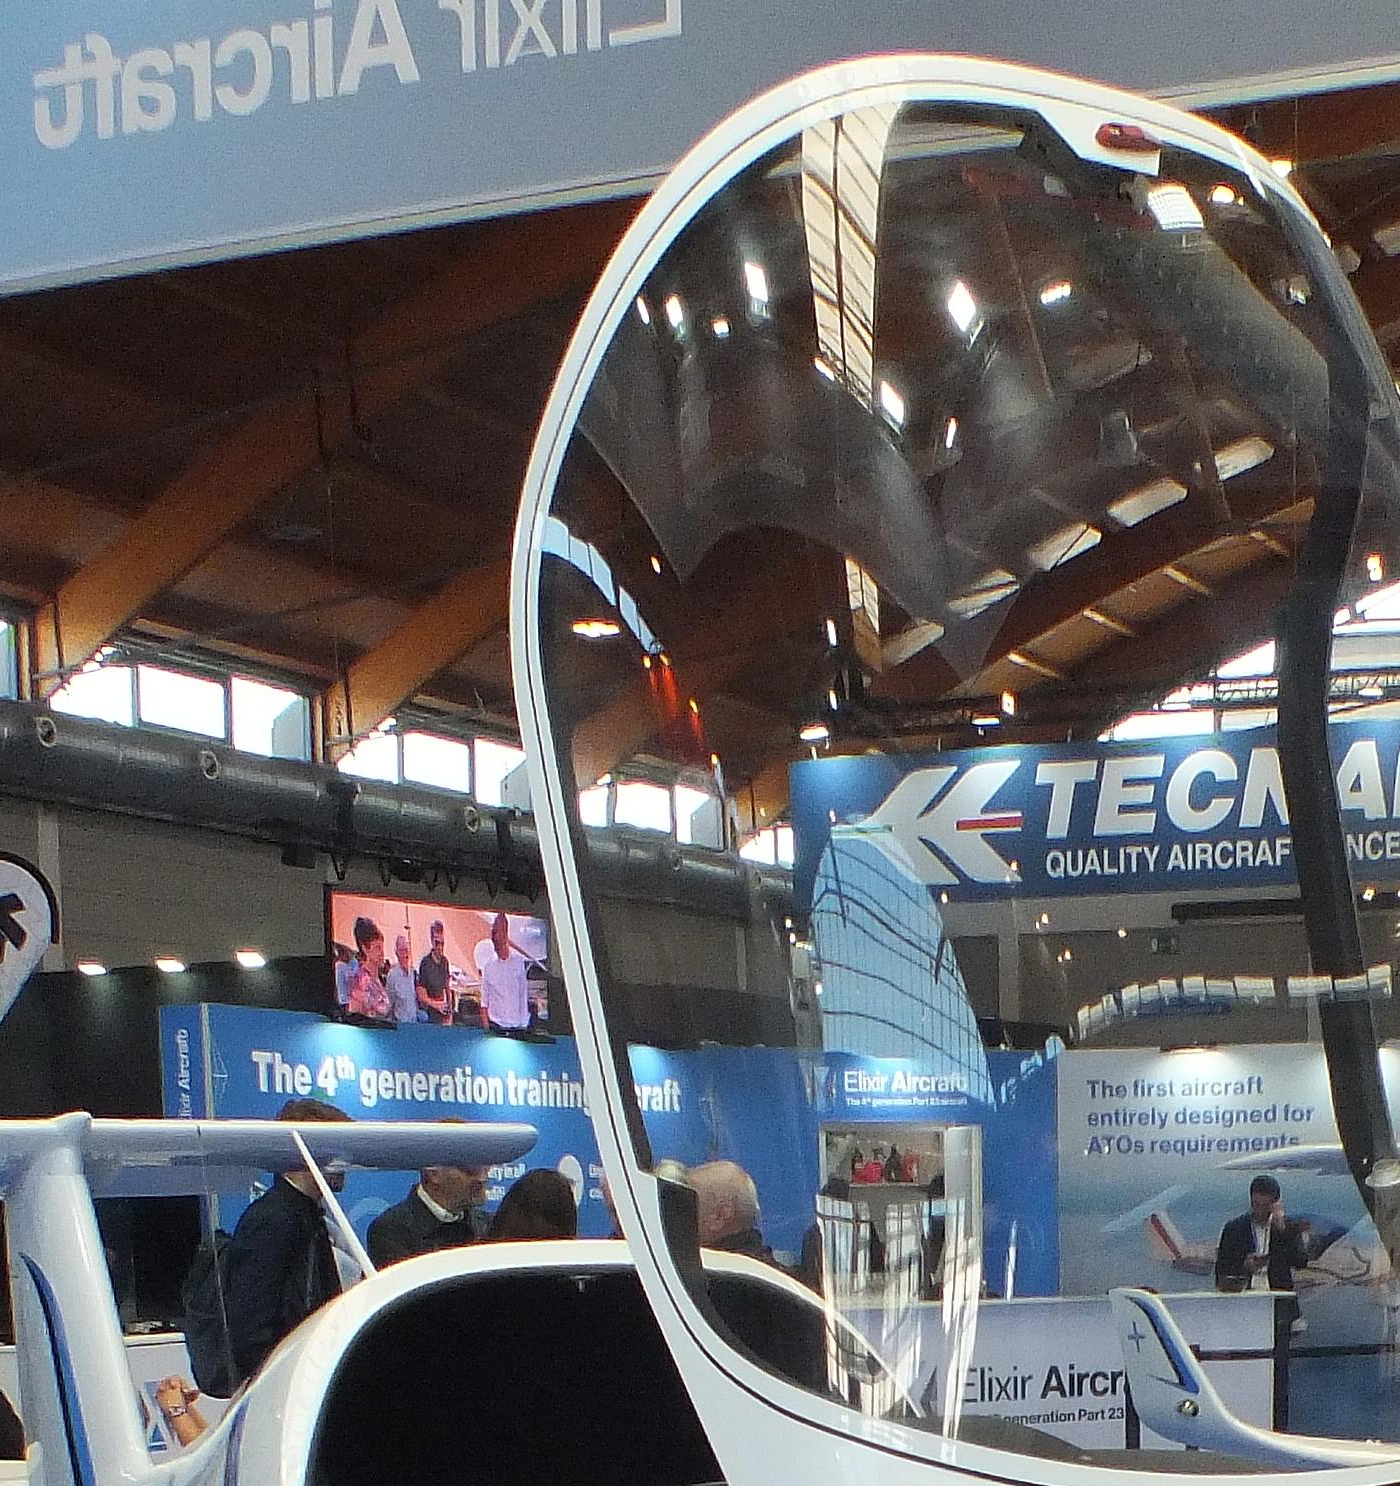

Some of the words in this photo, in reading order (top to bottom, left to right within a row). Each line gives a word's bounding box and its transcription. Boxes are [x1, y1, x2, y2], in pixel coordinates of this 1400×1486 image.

[1046, 844, 1160, 878] QUALITY
[1166, 838, 1291, 872] AIRCRAF
[1345, 831, 1400, 861] NCE
[251, 1051, 313, 1095] The
[317, 1055, 355, 1097] 4th
[359, 1066, 504, 1108] generation
[634, 1079, 682, 1112] raft
[844, 1069, 888, 1093] Elixir
[891, 1070, 966, 1093] Aircraft
[1086, 1080, 1127, 1098] The
[1133, 1079, 1175, 1098] first
[1182, 1076, 1264, 1097] aircraft
[1087, 1108, 1168, 1129] entirely
[1174, 1104, 1277, 1127] designed
[1283, 1104, 1315, 1123] for
[1086, 1134, 1144, 1155] ATOs
[1151, 1133, 1299, 1156] requirements
[964, 1366, 1033, 1403] Elixir
[1041, 1363, 1125, 1400] Aircr
[1078, 1408, 1105, 1422] Part
[1108, 1407, 1124, 1421] 23
